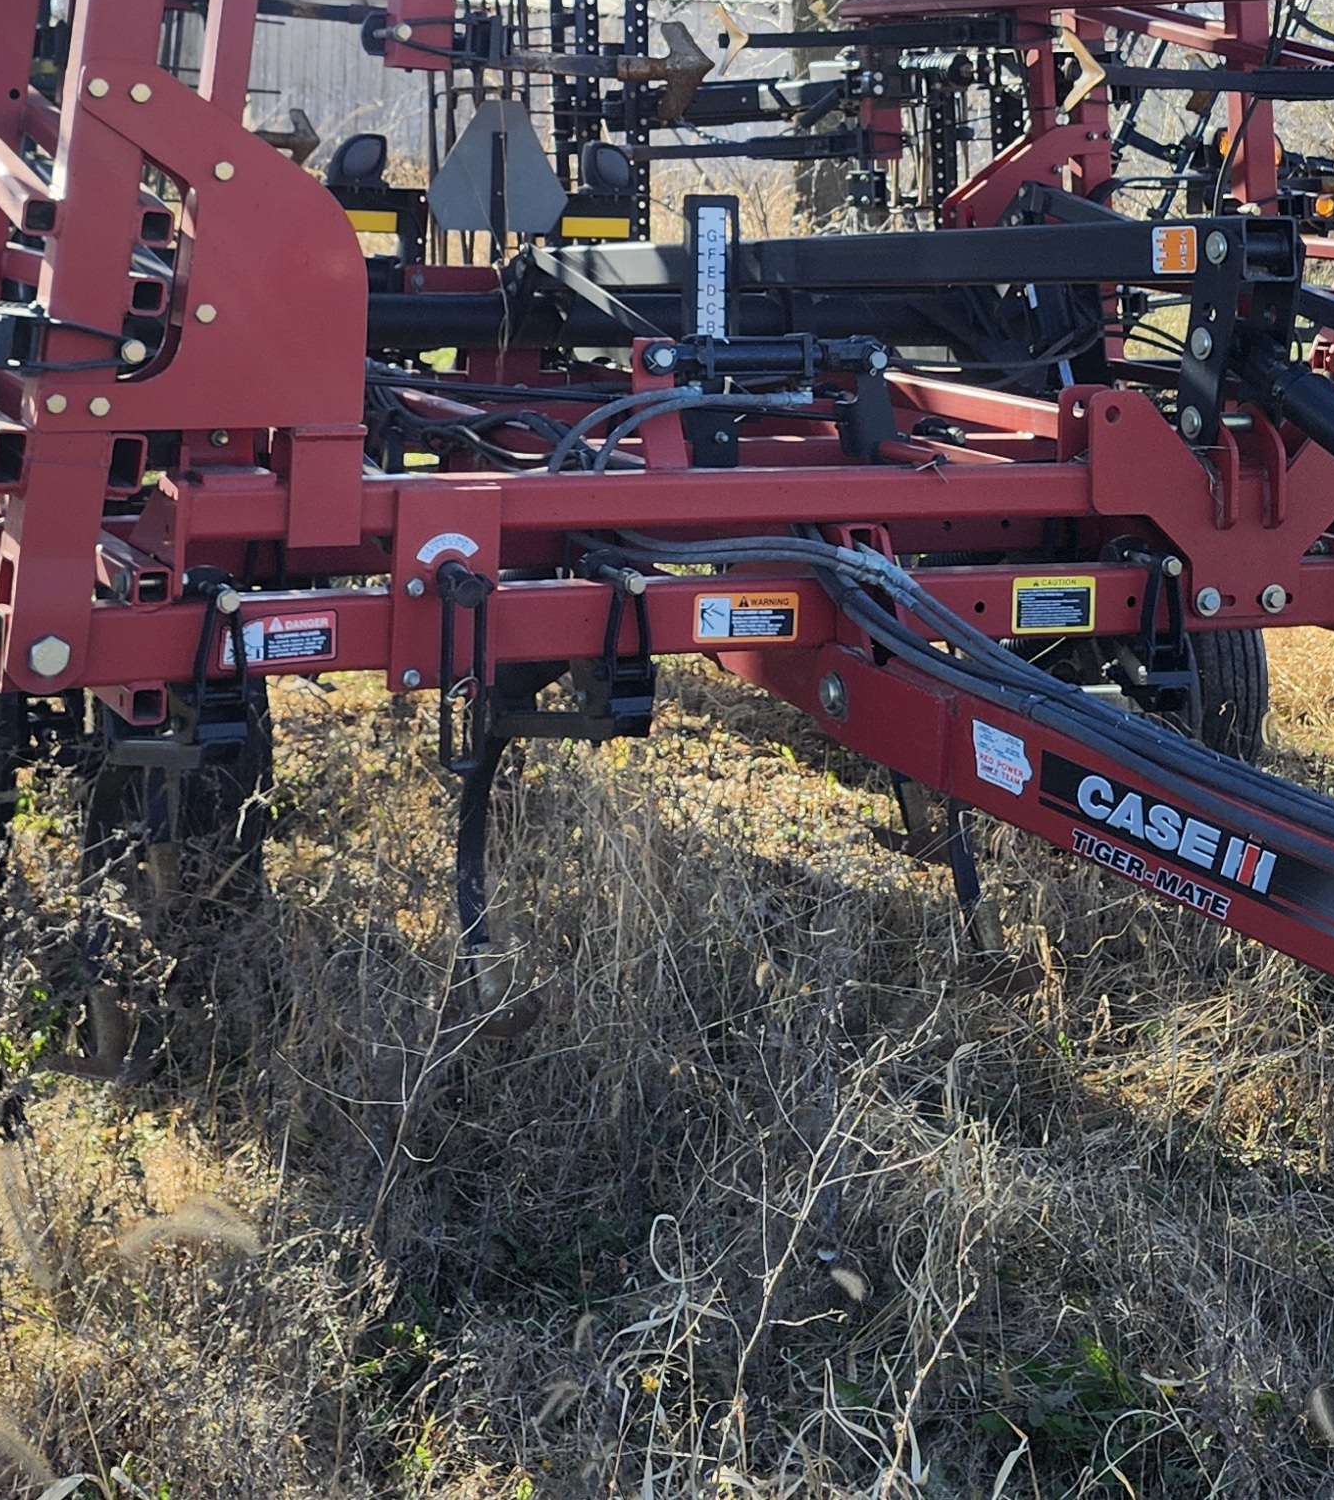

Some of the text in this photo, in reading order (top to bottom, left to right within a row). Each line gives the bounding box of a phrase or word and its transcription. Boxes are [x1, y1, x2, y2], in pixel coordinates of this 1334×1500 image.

[706, 229, 717, 242] G
[708, 247, 716, 260] F
[707, 266, 716, 278] E
[707, 284, 716, 297] D
[706, 302, 716, 315] C
[707, 321, 715, 333] B
[1040, 578, 1078, 587] CAUTION
[750, 598, 790, 606] WARNING
[284, 617, 329, 631] DANGER
[979, 752, 994, 765] RED
[997, 760, 1024, 779] POWER
[1077, 774, 1221, 870] CASE
[1071, 827, 1231, 921] TIGER-MATE
